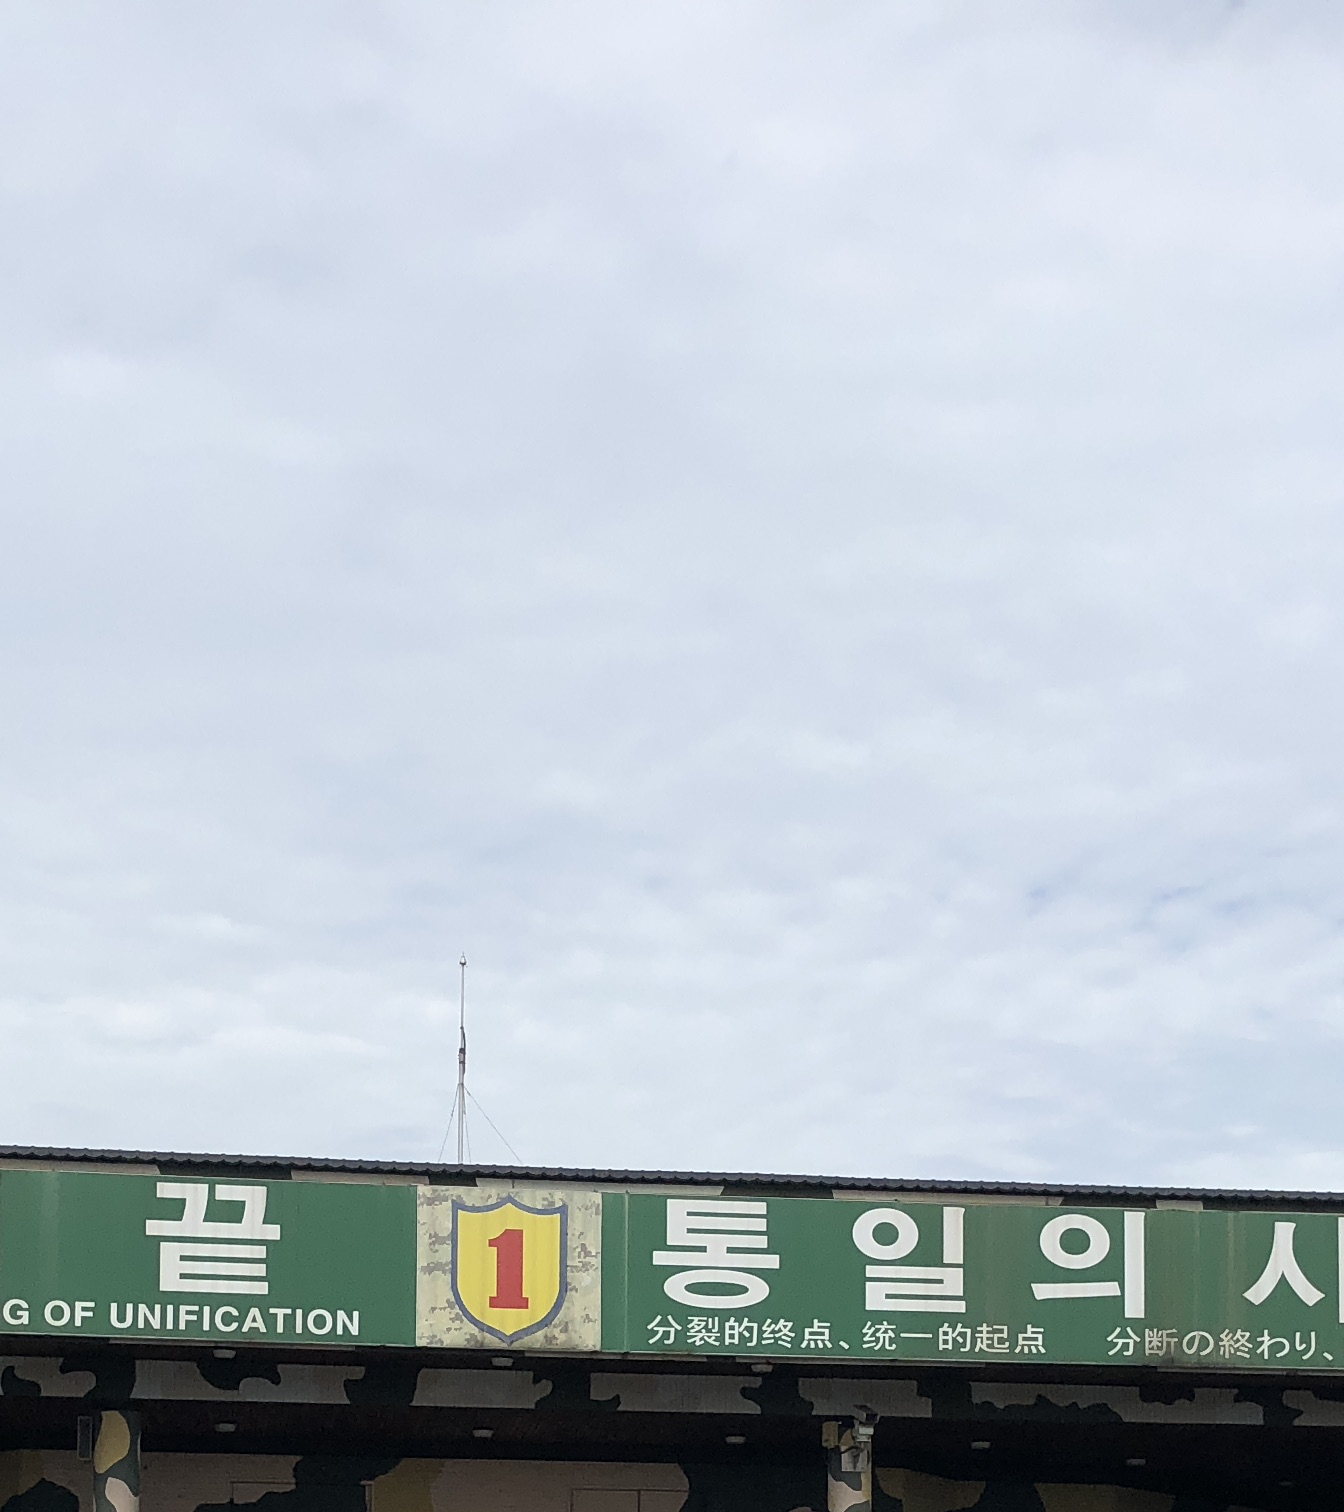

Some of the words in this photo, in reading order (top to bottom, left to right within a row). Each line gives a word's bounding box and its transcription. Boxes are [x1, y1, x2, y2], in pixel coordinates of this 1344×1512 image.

[145, 1181, 281, 1295] 끝
[488, 1228, 529, 1310] 1
[652, 1198, 1146, 1319] 통일의
[44, 1299, 96, 1327] OF
[110, 1302, 360, 1336] UNIFICATION
